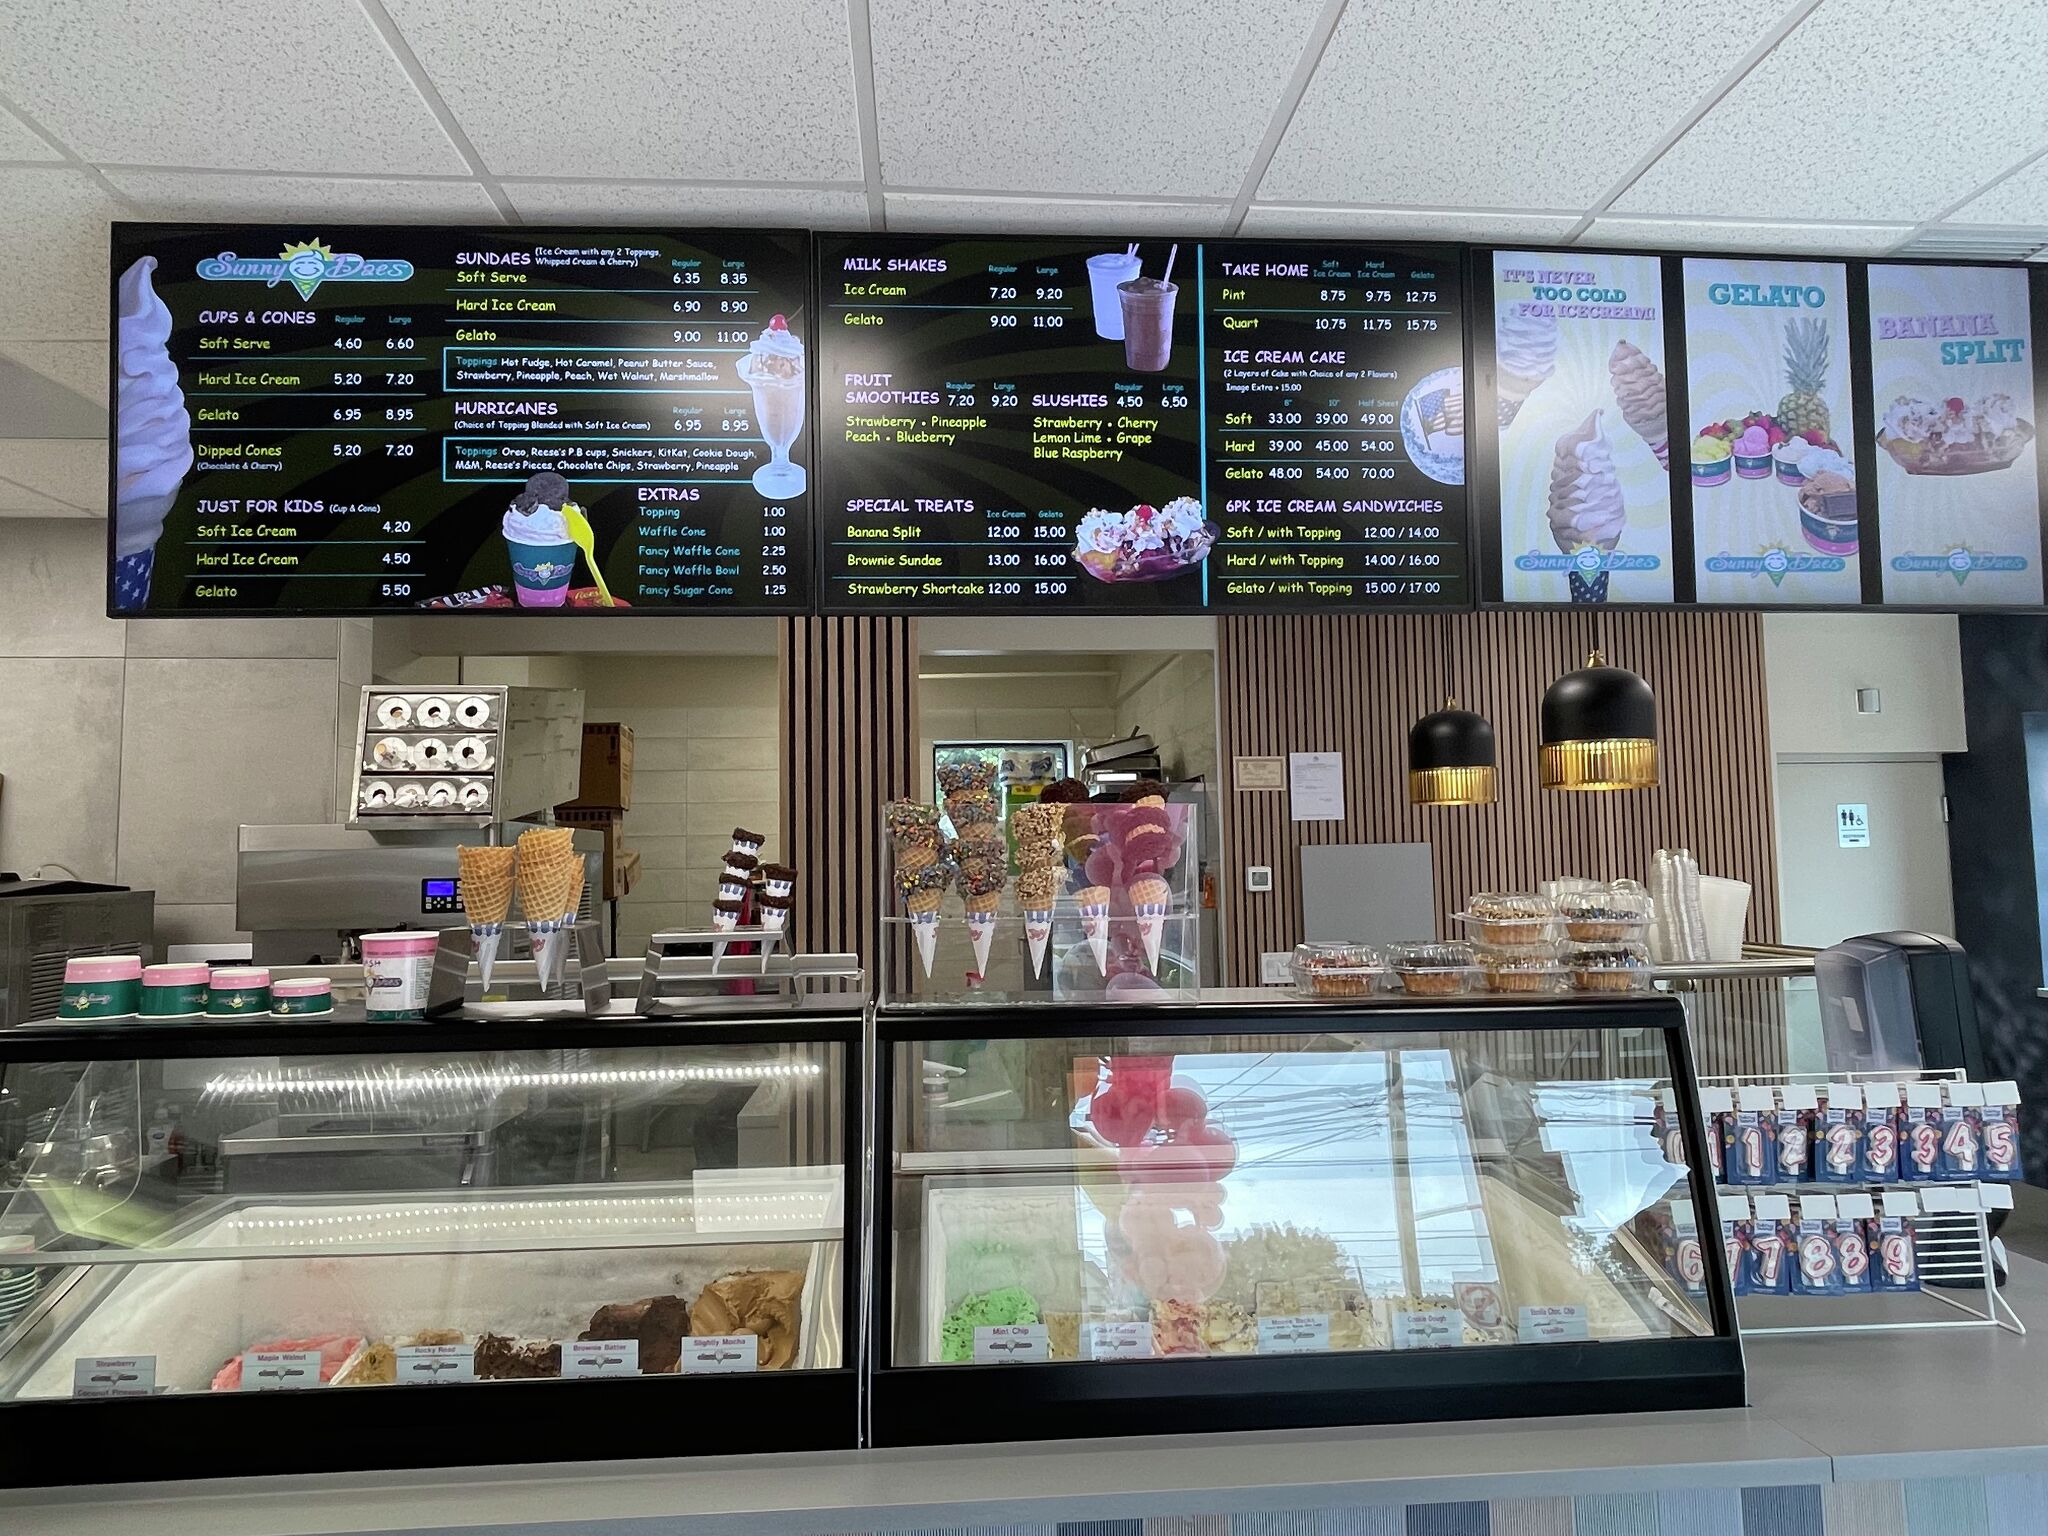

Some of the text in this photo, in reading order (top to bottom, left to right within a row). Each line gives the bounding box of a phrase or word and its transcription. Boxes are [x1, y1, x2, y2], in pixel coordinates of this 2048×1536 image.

[456, 252, 531, 265] SUNDAES
[535, 257, 638, 267] Whipped Cream & Cherry)
[205, 252, 288, 288] Sunny
[844, 259, 947, 272] MILK SHAKES
[1223, 263, 1308, 276] TAKE HOME
[457, 271, 527, 283] Soft Serve
[673, 273, 747, 285] 6.35 8.35
[1503, 269, 1595, 285] IT'S NEVER
[844, 284, 906, 296] Ice Cream
[990, 288, 1062, 299] 7.20 9.20
[1223, 289, 1245, 300] Pint
[1321, 290, 1436, 302] 8.75 9.75 12.75
[1532, 286, 1626, 302] TOO COLD
[1708, 283, 1826, 309] GELATO
[457, 299, 556, 311] Hard Ice Cream
[673, 301, 748, 313] 6.90 8.90
[1518, 303, 1655, 320] FOR ICECREAM!
[200, 312, 316, 324] CUPS & CONES
[844, 314, 883, 325] Gelato
[991, 316, 1062, 327] 9.00 11.00
[1223, 317, 1258, 329] Quart
[1877, 315, 1998, 339] BANANA
[456, 329, 496, 341] Gelato
[673, 331, 748, 343] 9.00 11.00
[200, 338, 270, 349] Soft Serve
[334, 338, 414, 349] 4.60 6.60
[1224, 351, 1345, 363] ICE CREAM CAKE
[1941, 340, 2025, 365] SPLIT
[456, 357, 716, 370] Toppings Hot Fudge, Hot Caramel, Peanut Butter Sauce,
[199, 374, 300, 385] Hard Ice Cream
[845, 374, 892, 386] FRUIT
[1226, 384, 1249, 392] Image
[845, 392, 939, 404] SMOOTHIES
[948, 395, 1018, 407] 7.20 9.20
[1032, 395, 1108, 407] SLUSHIES
[1117, 396, 1188, 408] 4.50 6.50
[333, 409, 413, 420] 6.95 8.95
[455, 402, 558, 415] HURRICANES
[673, 406, 746, 416] Regular Large
[198, 409, 239, 421] Gelato
[1226, 414, 1252, 425] Soft
[1269, 414, 1393, 424] 33.00 39.00 49.00
[674, 420, 749, 431] 6.95 8.95
[846, 416, 987, 429] Strawberry Pineapple
[846, 431, 955, 445] Peach Blueberry
[198, 445, 281, 458] Dipped Cones
[1034, 448, 1123, 461] Blue Raspberry
[638, 488, 699, 500] EXTRAS
[197, 501, 240, 513] JUST
[247, 501, 277, 512] FOR
[284, 500, 324, 512] KIDS
[329, 503, 347, 514] (Cup
[358, 503, 380, 514] Cone)
[764, 507, 785, 517] 1.00
[847, 500, 974, 512] SPECIAL TREATS
[1226, 500, 1443, 513] 6PK ICE CREAM SANDWICHES
[639, 507, 680, 519] Topping
[382, 521, 410, 532] 4.20
[988, 527, 1066, 538] 12.00 15.00
[848, 526, 921, 540] Banana Split
[848, 555, 942, 567] Brownie Sundae
[1520, 550, 1575, 577] Sunny
[639, 565, 739, 577] Fancy Waffle Bowl
[762, 565, 786, 575] 2.50
[382, 584, 410, 596] 5.50
[639, 585, 733, 597] Fancy Sugar Cone
[765, 585, 786, 595] 1.25
[992, 1327, 1029, 1335] Mint Chip
